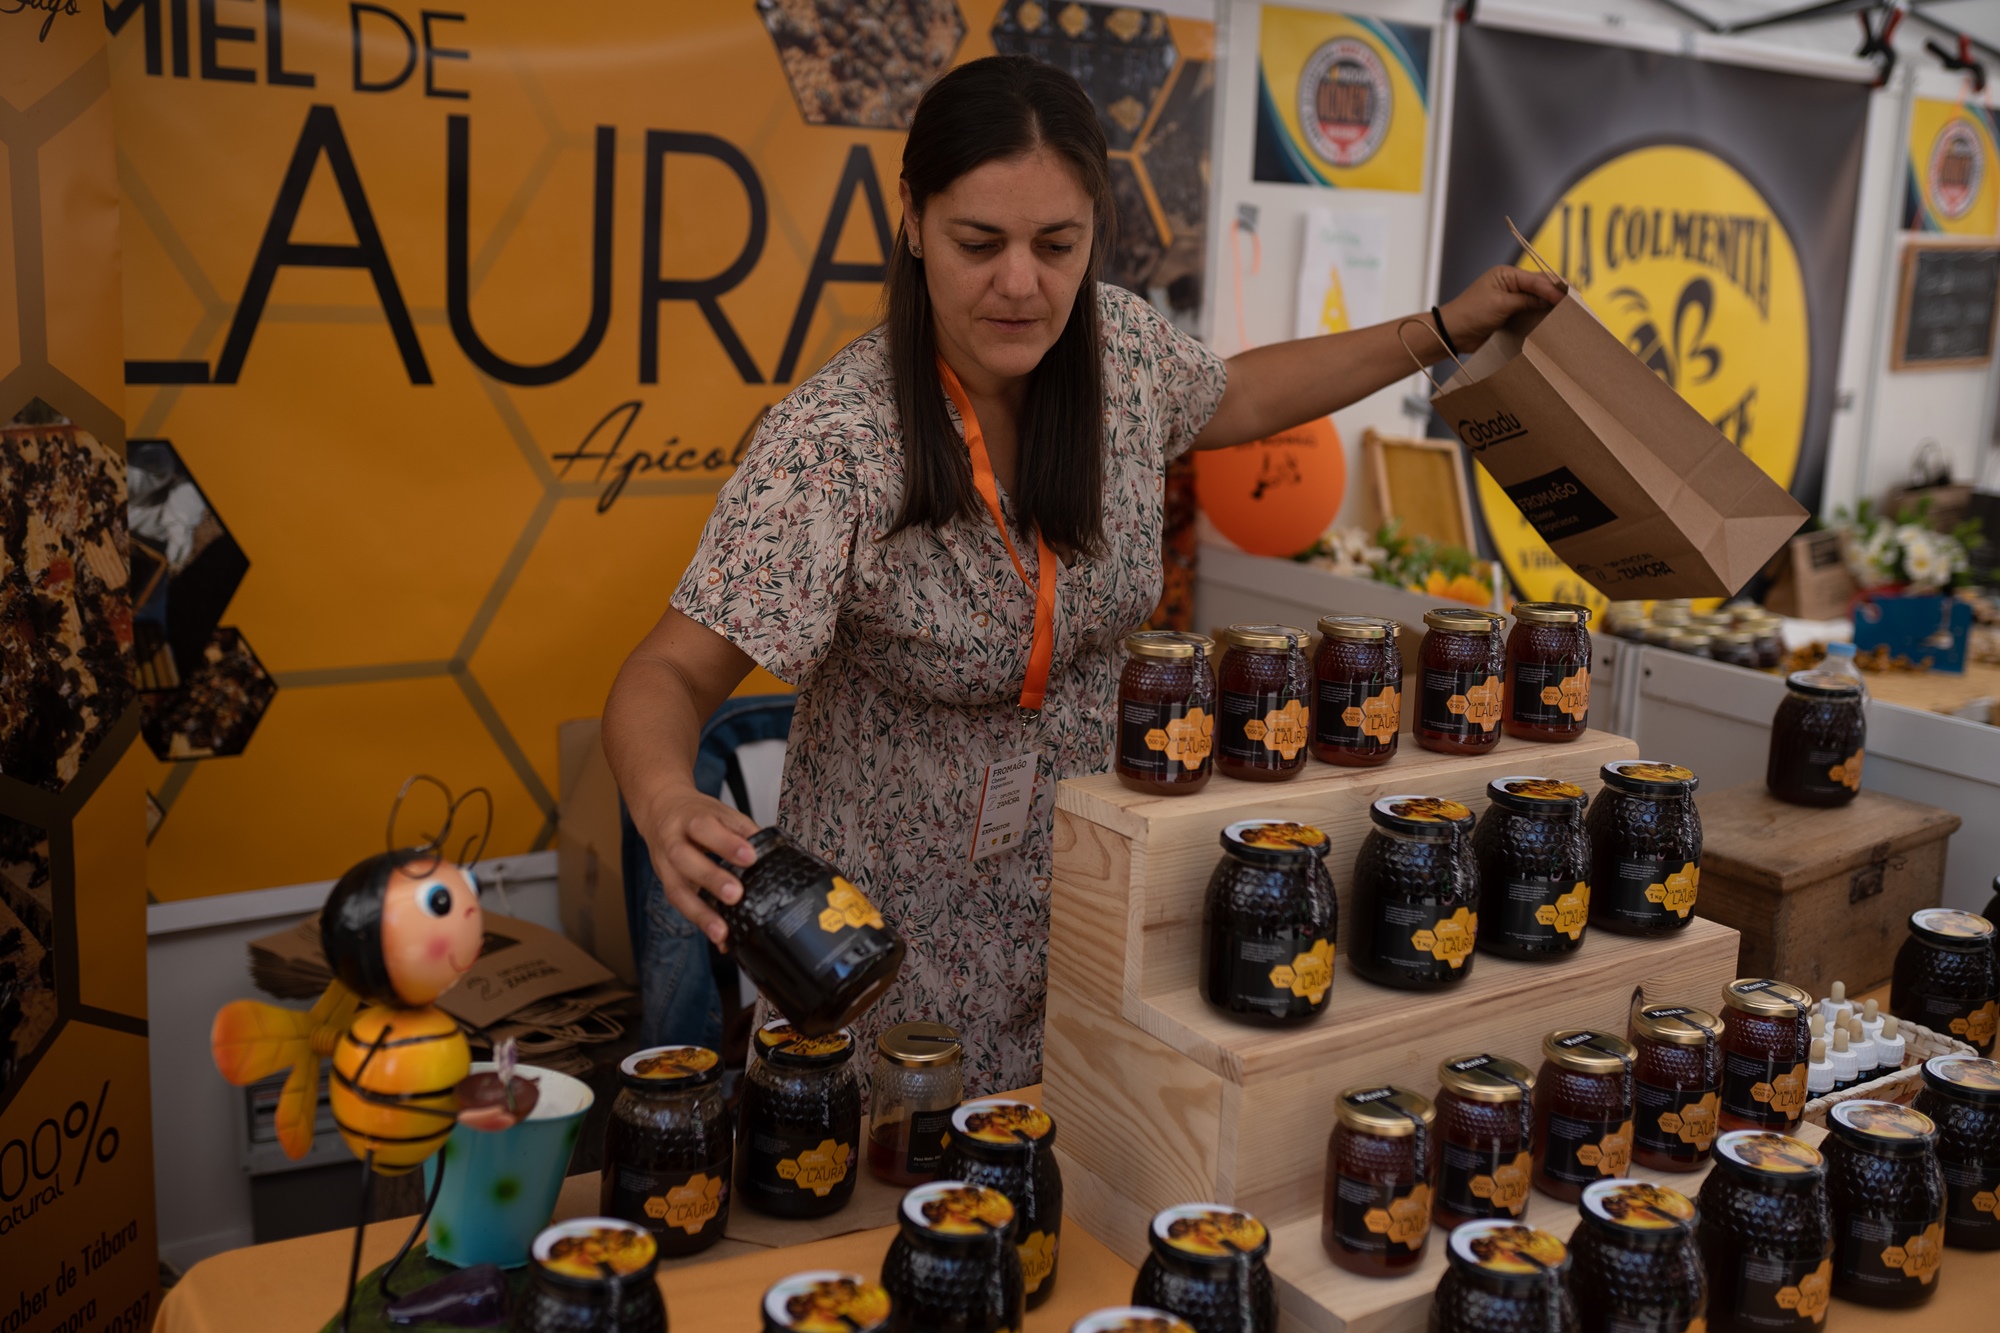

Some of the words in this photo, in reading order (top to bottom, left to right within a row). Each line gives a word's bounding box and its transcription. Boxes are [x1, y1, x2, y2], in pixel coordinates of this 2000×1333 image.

[349, 2, 471, 101] DE
[124, 103, 900, 388] AURA
[981, 822, 1011, 836] EXPOSITOR
[806, 1165, 844, 1183] LAURA
[676, 1201, 716, 1221] LAURA
[56, 1261, 78, 1297] de
[81, 1220, 137, 1277] Tábara
